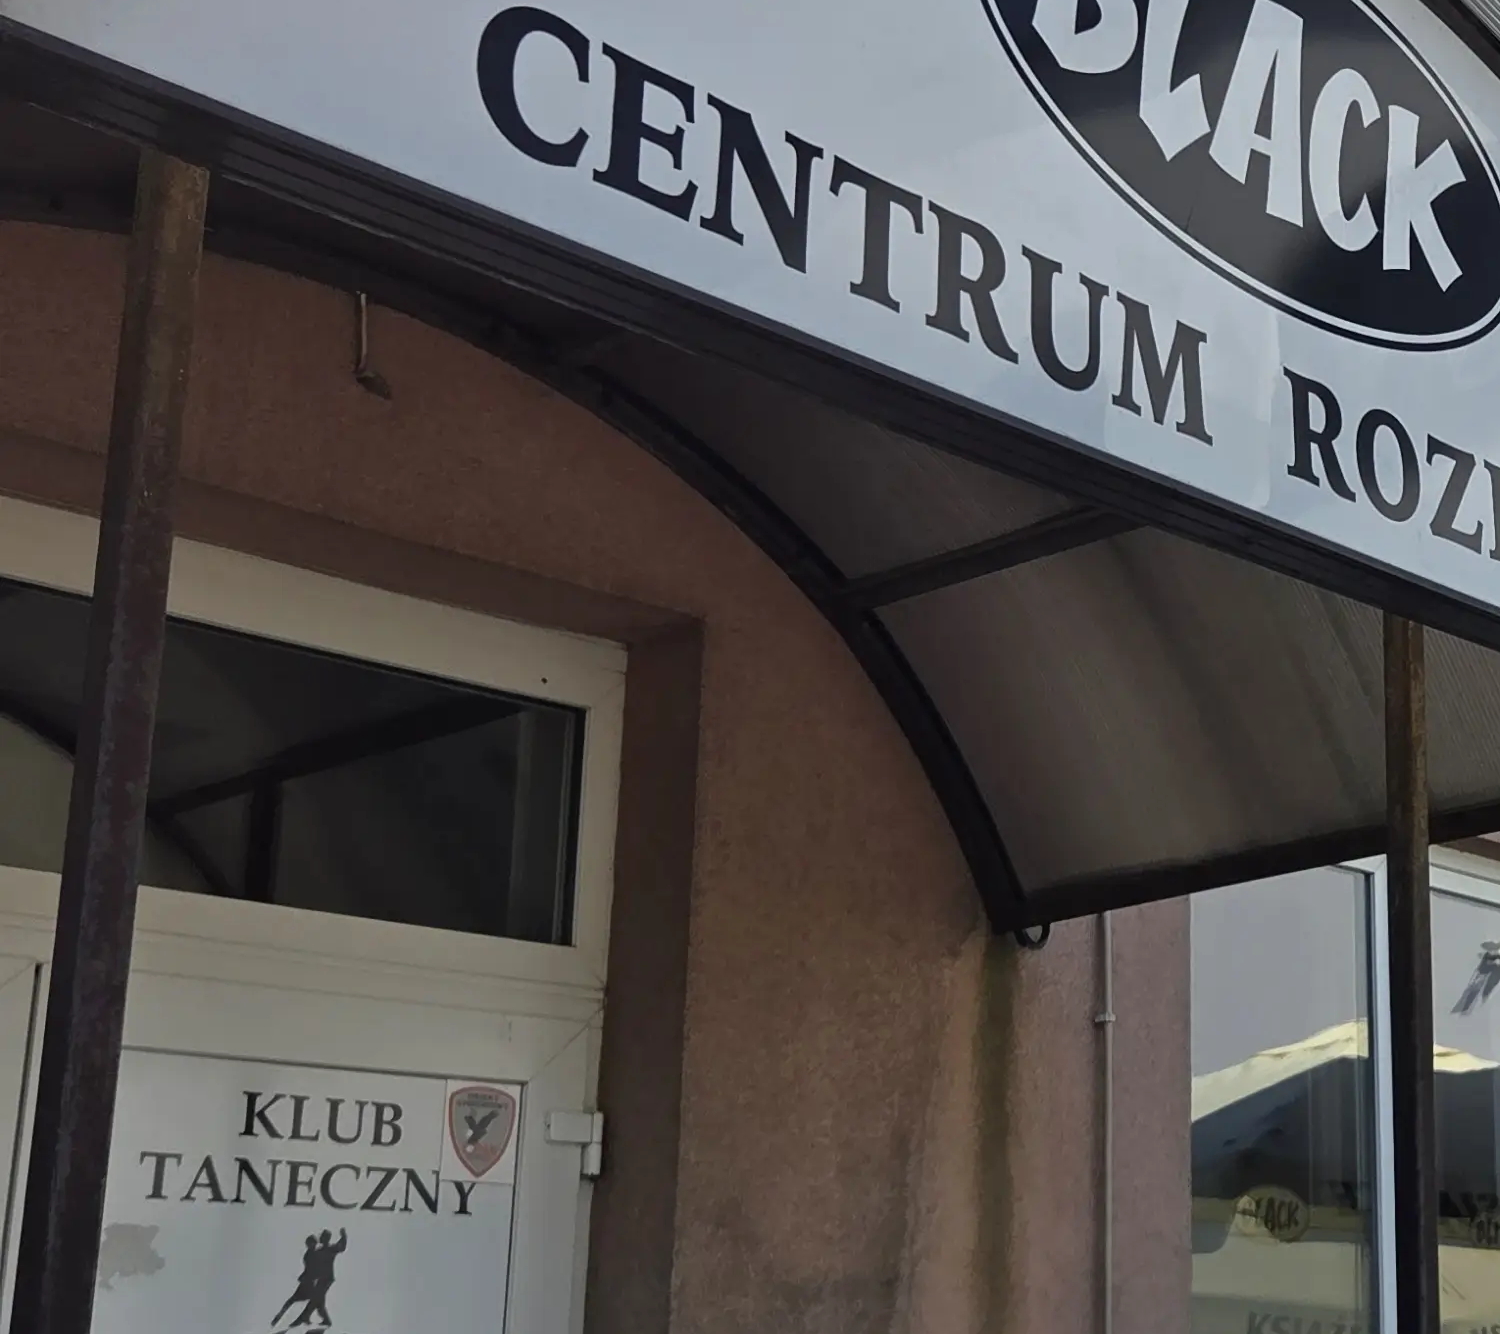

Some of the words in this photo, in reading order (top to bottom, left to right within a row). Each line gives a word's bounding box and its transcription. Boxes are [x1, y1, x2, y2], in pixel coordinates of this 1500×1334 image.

[476, 6, 1213, 446] CENTRUM
[239, 1091, 403, 1146] KLUB
[140, 1151, 476, 1215] TANECZNY
